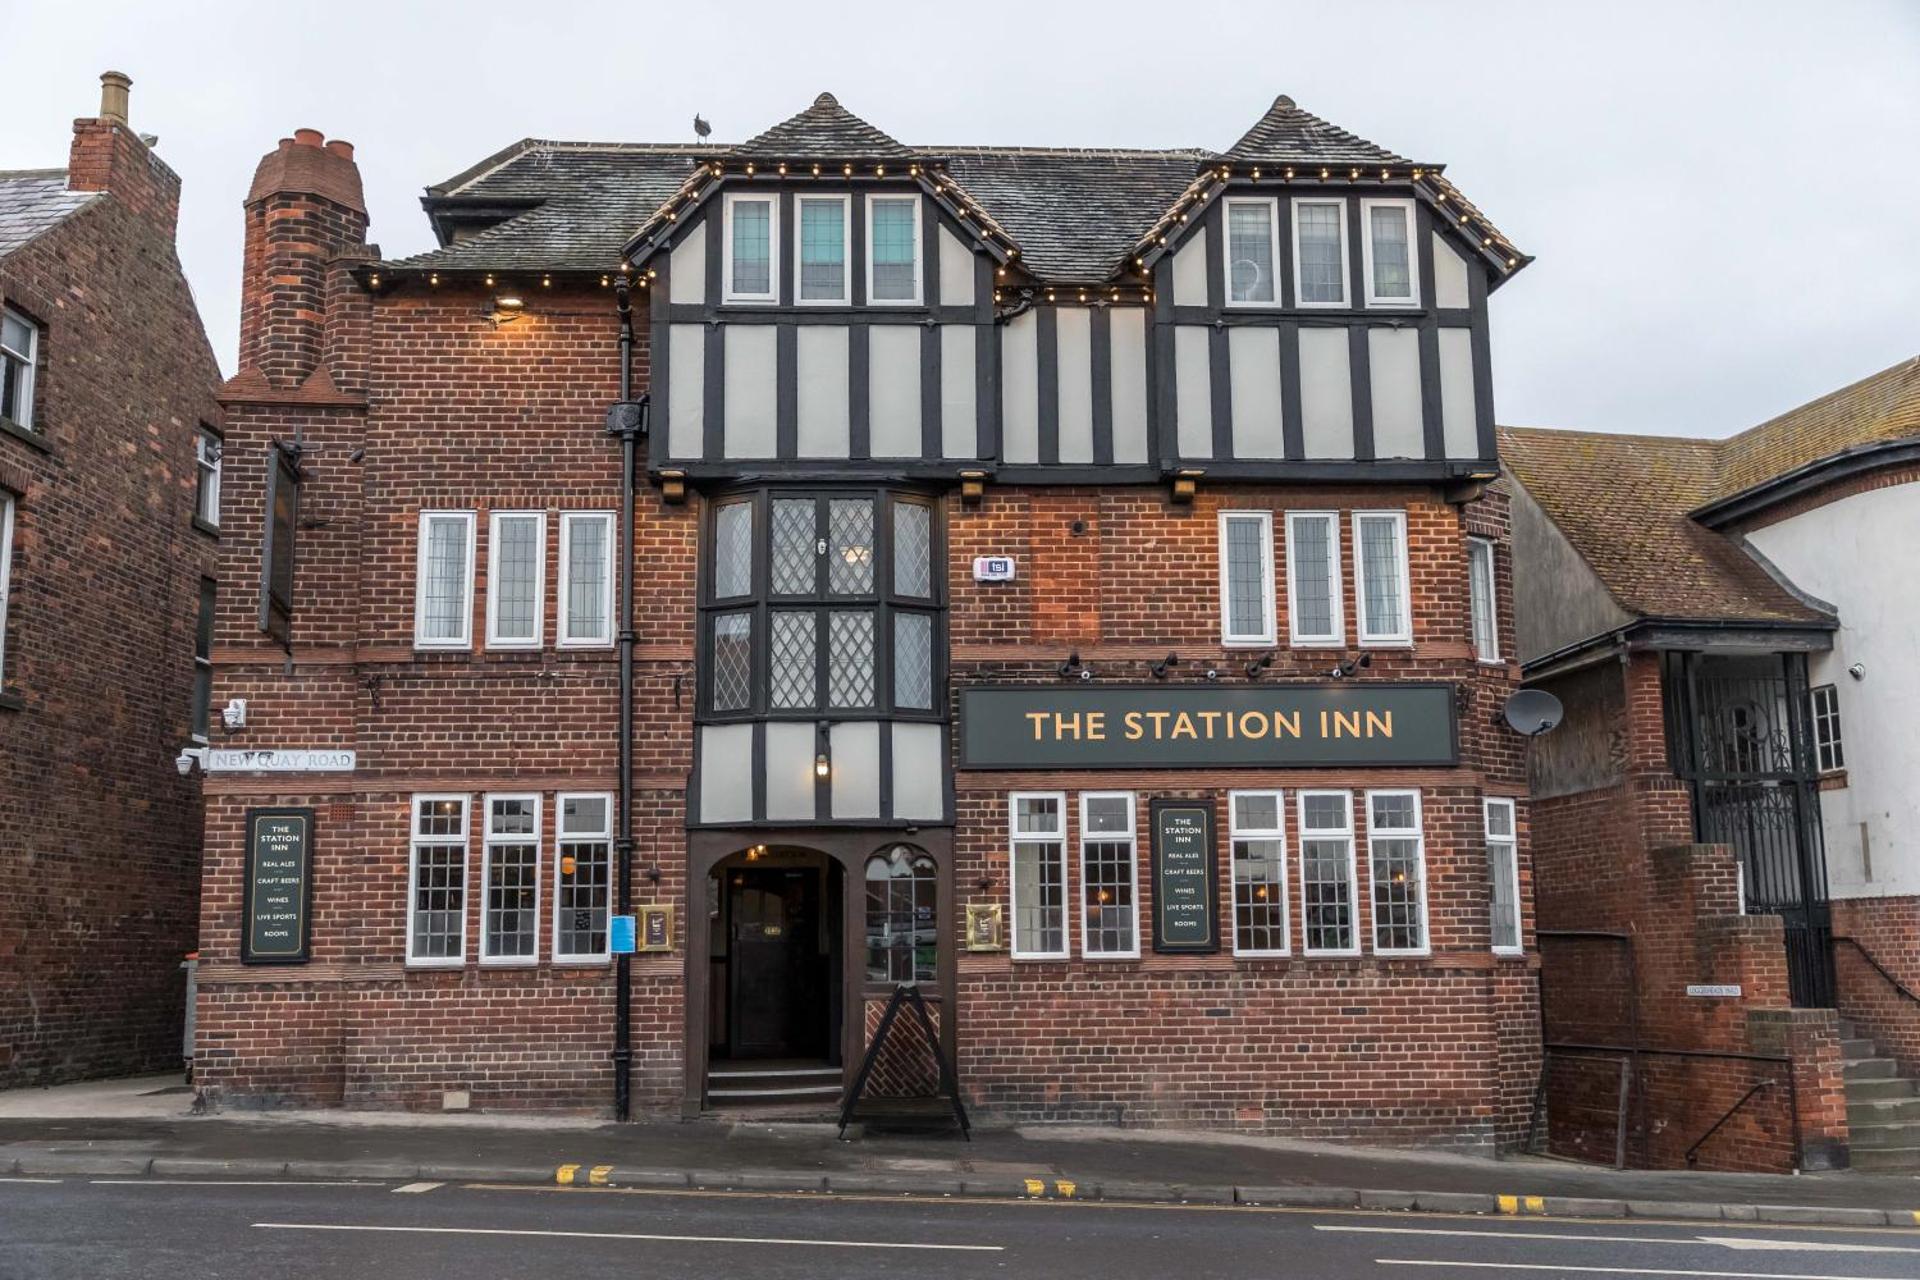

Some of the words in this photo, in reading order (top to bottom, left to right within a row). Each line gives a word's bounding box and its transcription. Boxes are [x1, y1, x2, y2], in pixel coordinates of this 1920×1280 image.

[1025, 712, 1106, 740] THE
[1124, 711, 1301, 740] STATION
[1319, 710, 1393, 739] INN
[216, 752, 254, 767] NEW
[257, 752, 301, 768] QUAY
[308, 754, 351, 767] ROAD
